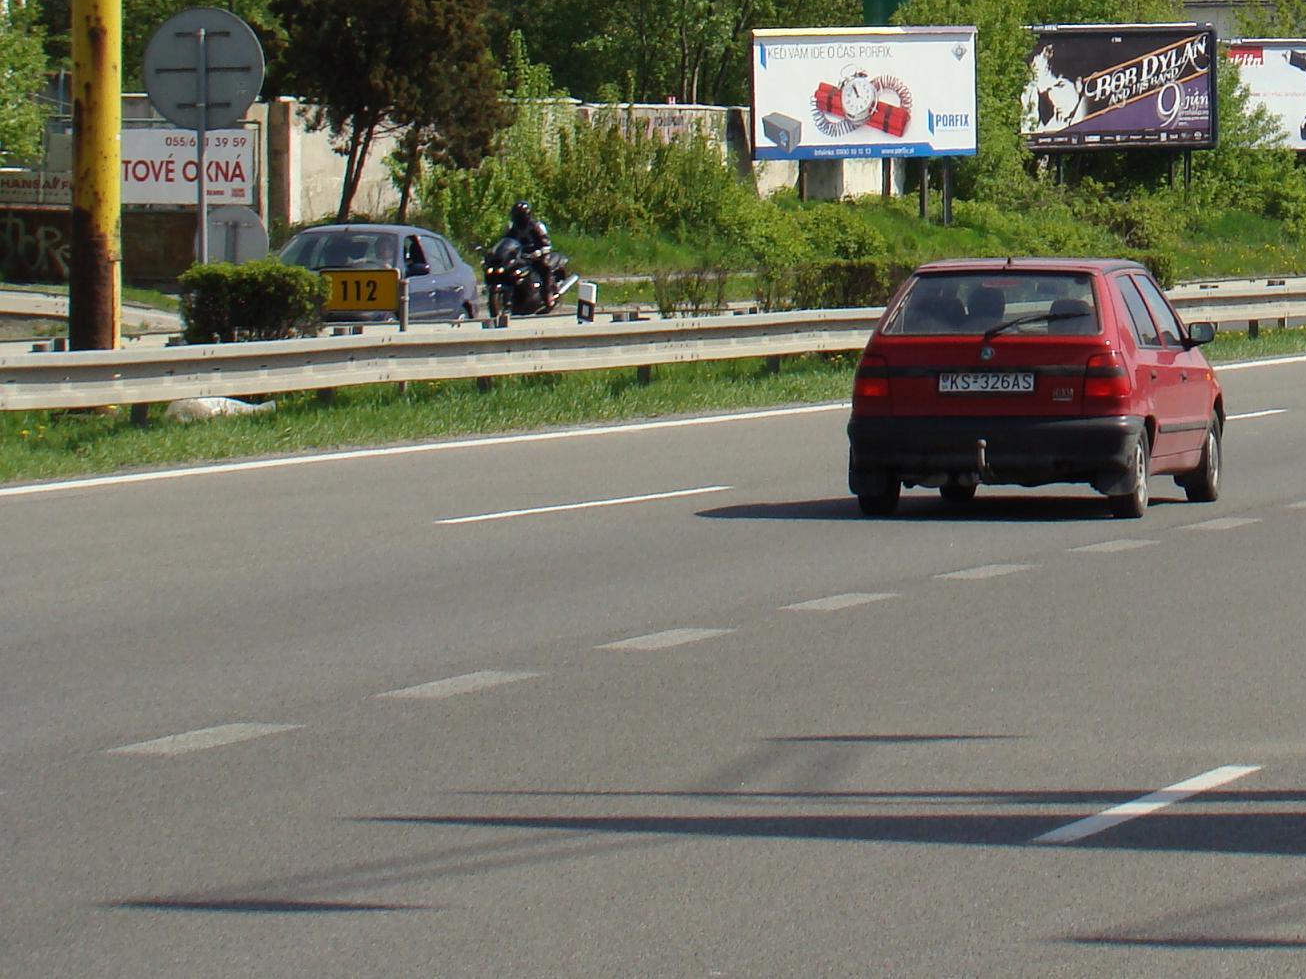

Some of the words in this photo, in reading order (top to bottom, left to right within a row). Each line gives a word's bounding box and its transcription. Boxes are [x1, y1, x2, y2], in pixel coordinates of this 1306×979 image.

[828, 46, 835, 58] O
[1085, 67, 1137, 101] BOB
[1141, 33, 1208, 81] DYLAN
[936, 113, 969, 127] PORFIX
[214, 138, 228, 147] 39
[232, 138, 247, 147] 59
[121, 154, 175, 182] TOVÉ
[341, 280, 378, 301] 112
